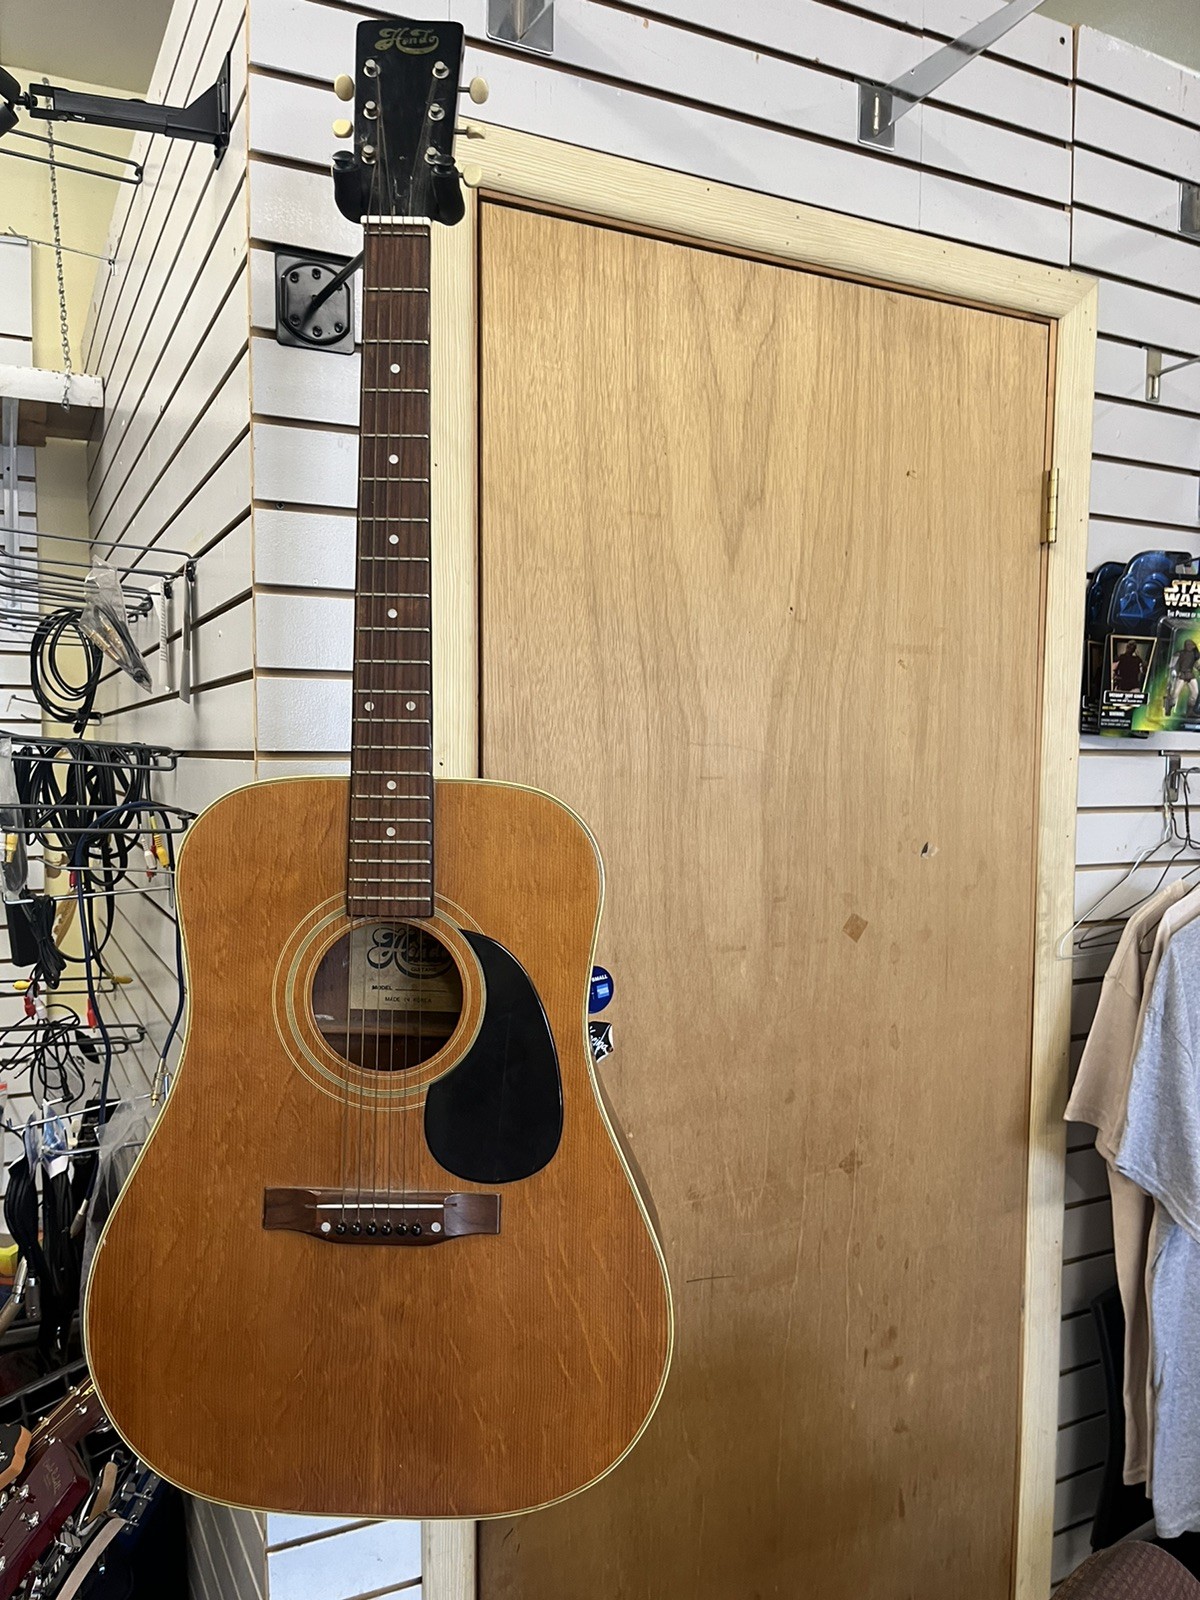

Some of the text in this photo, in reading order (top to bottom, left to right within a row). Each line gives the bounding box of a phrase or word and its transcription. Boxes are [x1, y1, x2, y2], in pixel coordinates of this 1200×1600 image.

[374, 27, 440, 55] Hondo
[1163, 579, 1200, 594] STA
[1164, 593, 1200, 608] WAR
[367, 927, 453, 979] Hond
